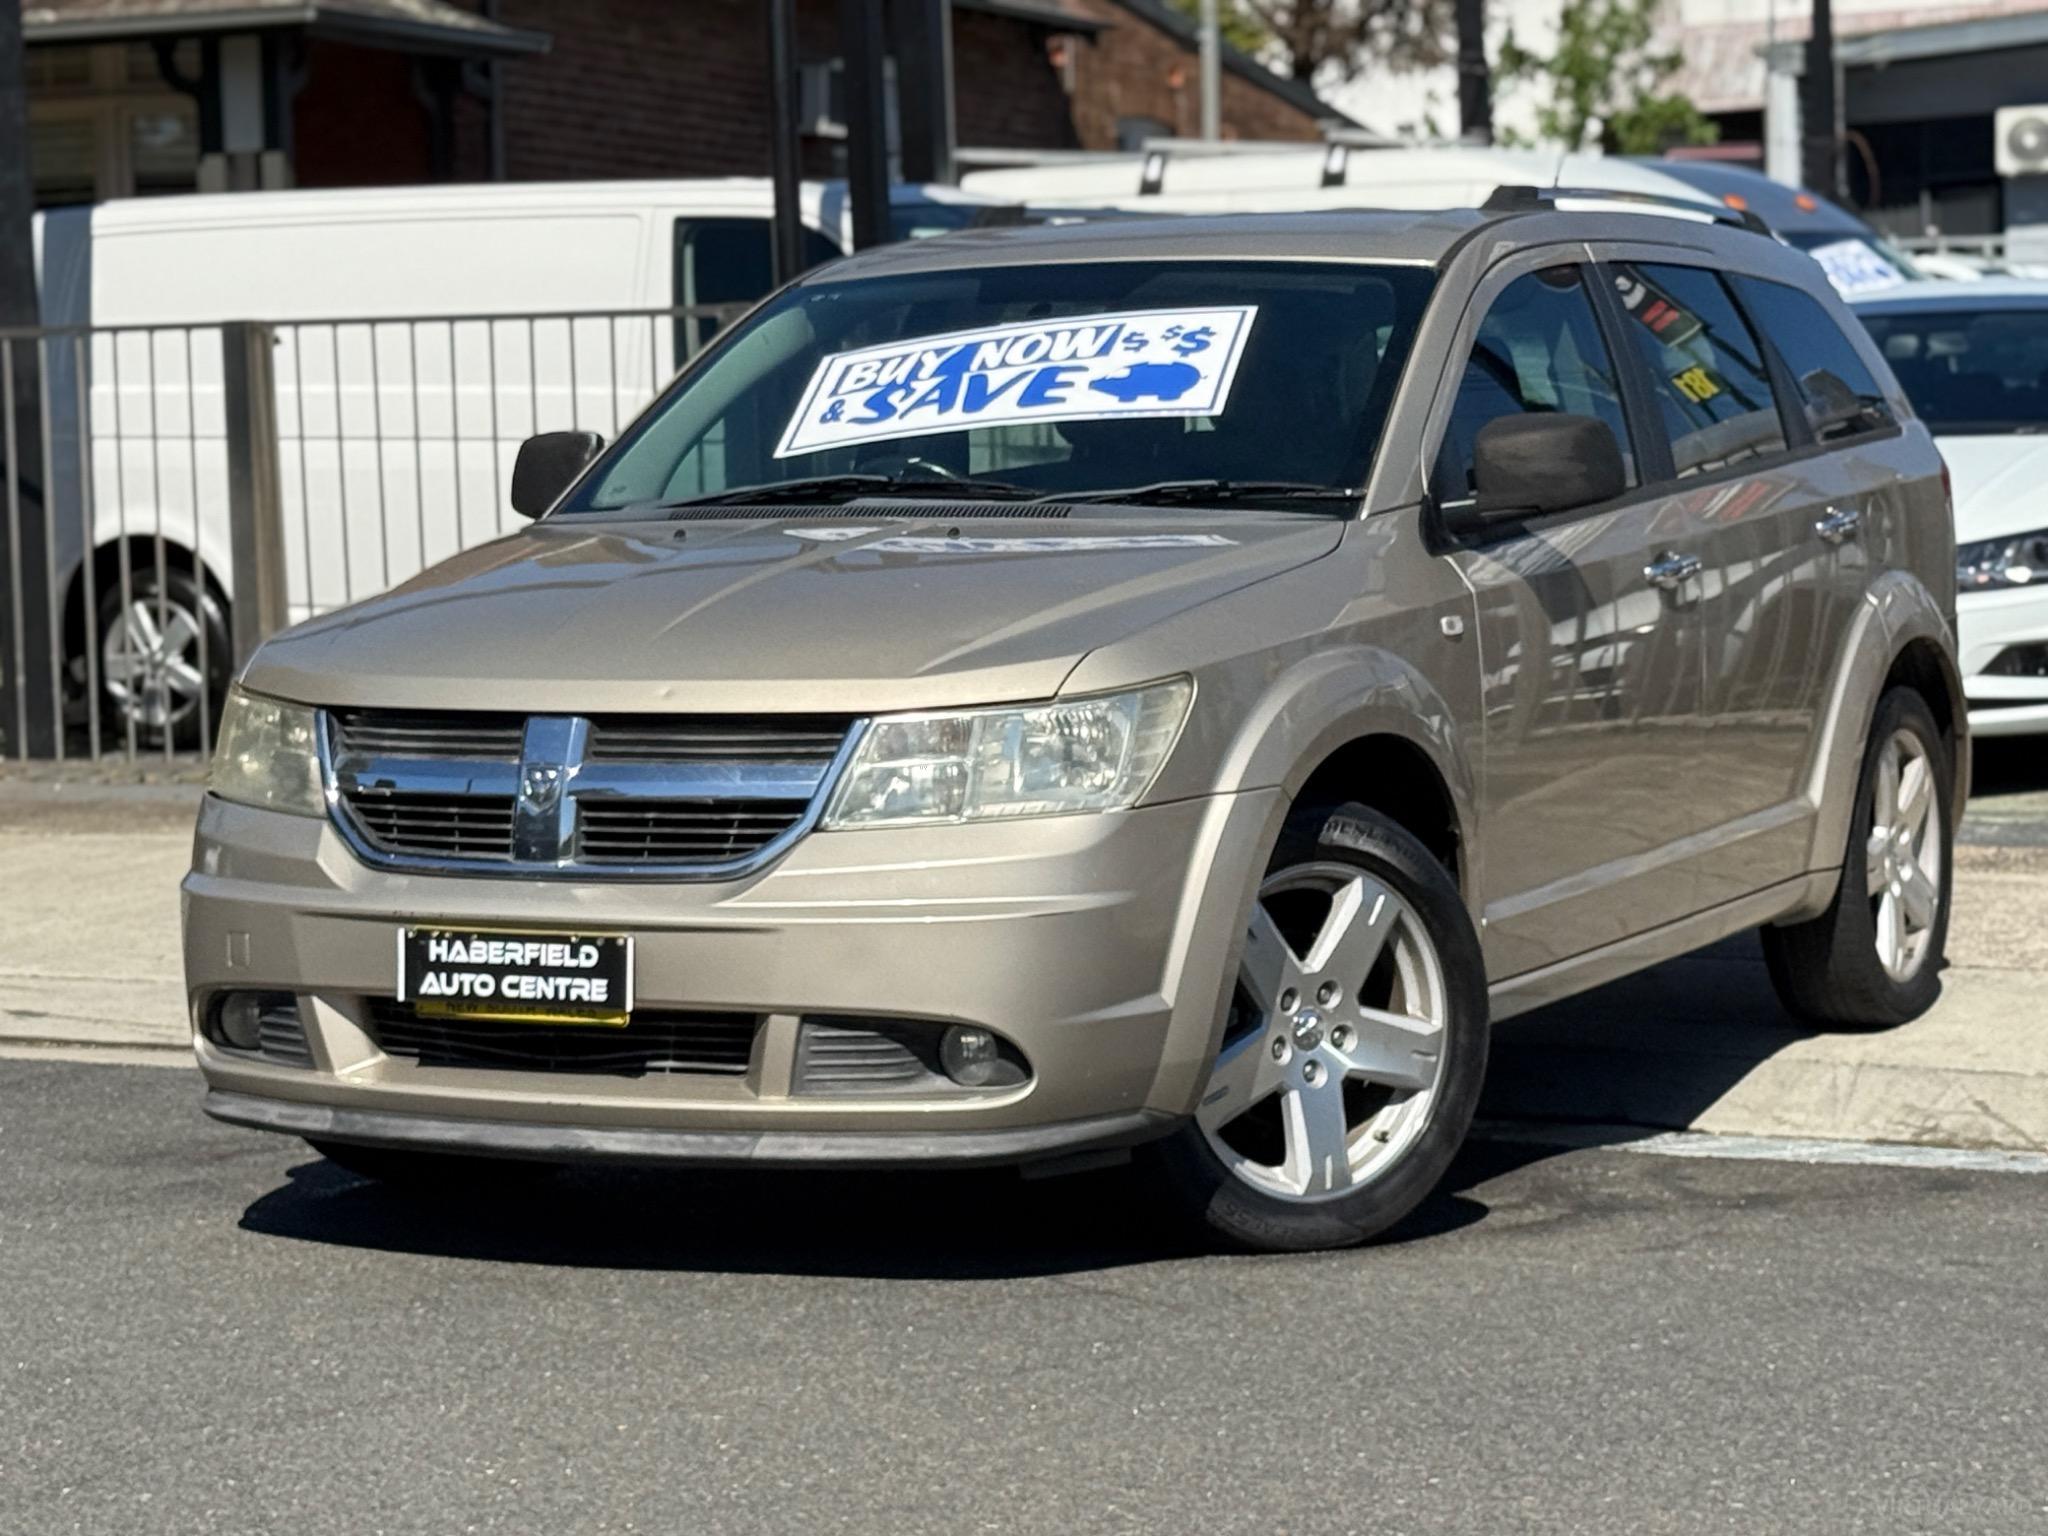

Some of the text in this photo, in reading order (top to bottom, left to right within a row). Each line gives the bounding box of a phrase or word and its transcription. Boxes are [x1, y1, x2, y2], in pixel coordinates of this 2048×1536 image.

[837, 345, 966, 395] BUY
[969, 323, 1120, 372] NOW
[819, 365, 1090, 425] & SAVE
[429, 938, 599, 969] HABERFIELD
[419, 971, 609, 1003] AUTO CENTRE
